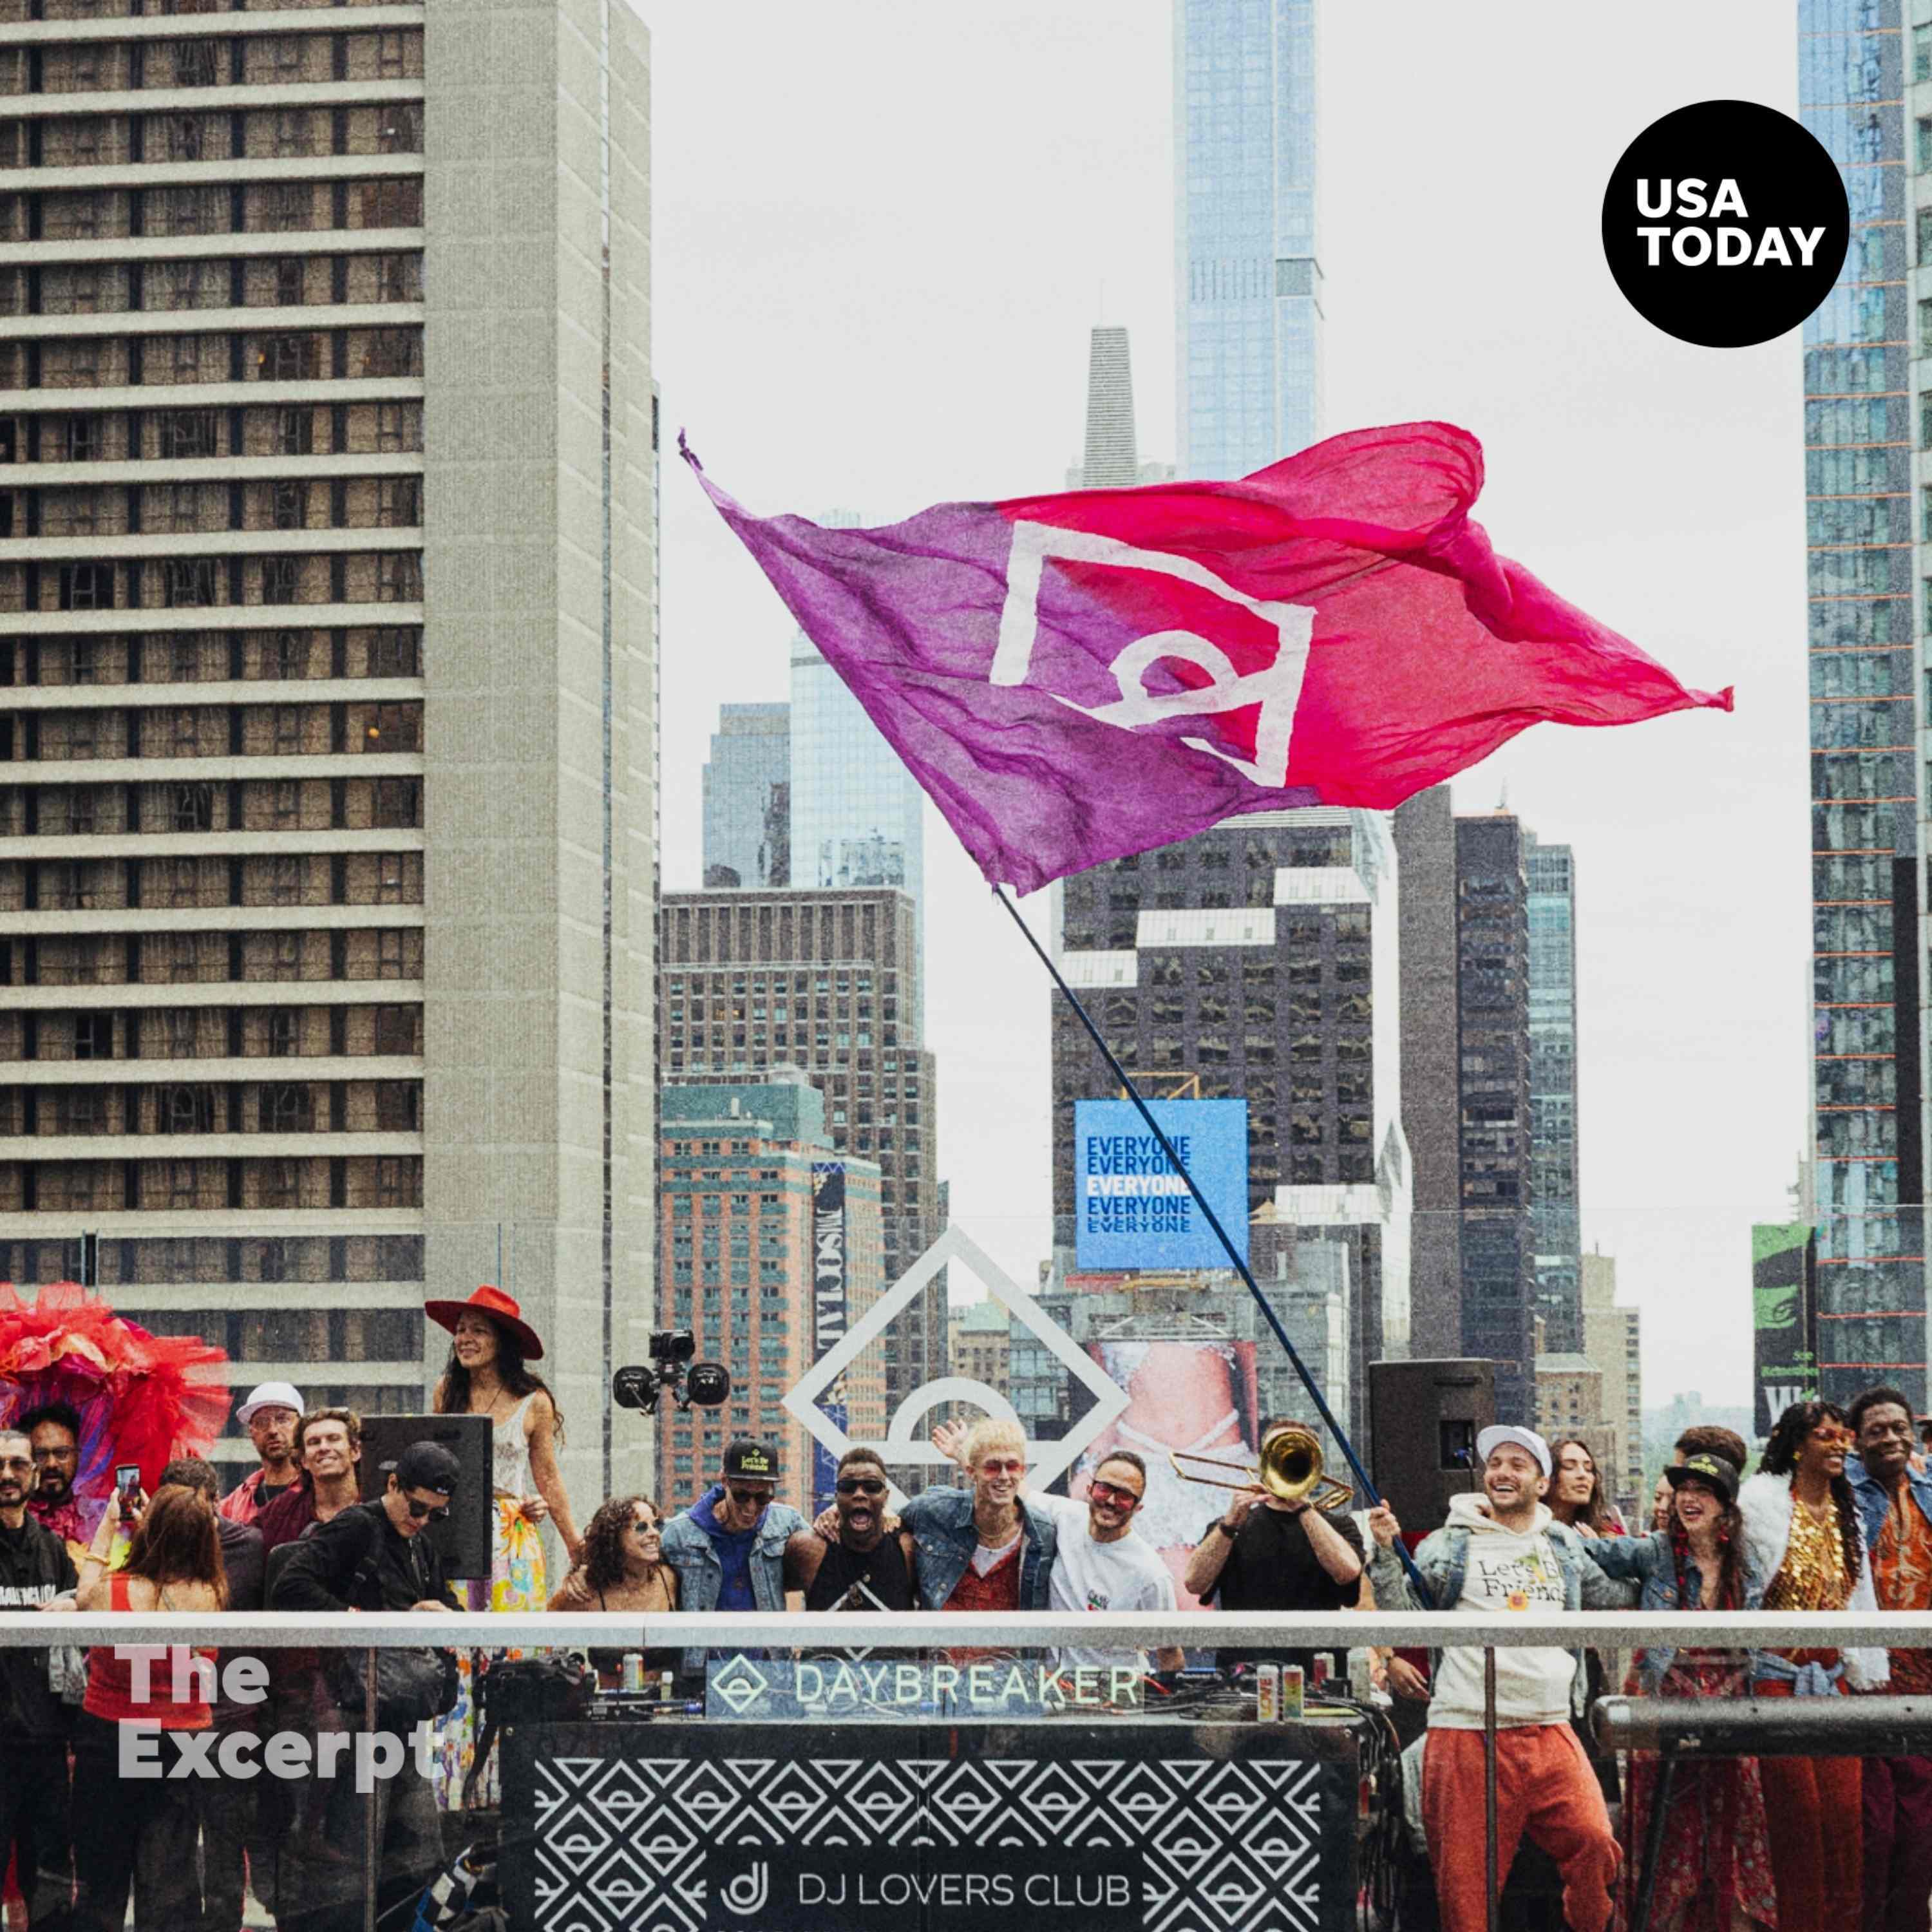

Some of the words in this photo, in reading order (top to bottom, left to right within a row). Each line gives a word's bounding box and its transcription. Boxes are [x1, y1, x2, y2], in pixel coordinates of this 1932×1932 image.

[1087, 1136, 1191, 1155] EVERYONE
[1087, 1156, 1191, 1175] EVERYONE
[1087, 1175, 1191, 1196] EVERYONE
[1087, 1196, 1191, 1215] EVERYONE
[1478, 1560, 1535, 1577] Let's
[1542, 1560, 1559, 1579] B
[796, 1664, 1138, 1704] DAYBREAKER
[799, 1873, 846, 1904] DJ
[858, 1874, 1014, 1906] LOVERS
[1025, 1874, 1130, 1906] CLUB
